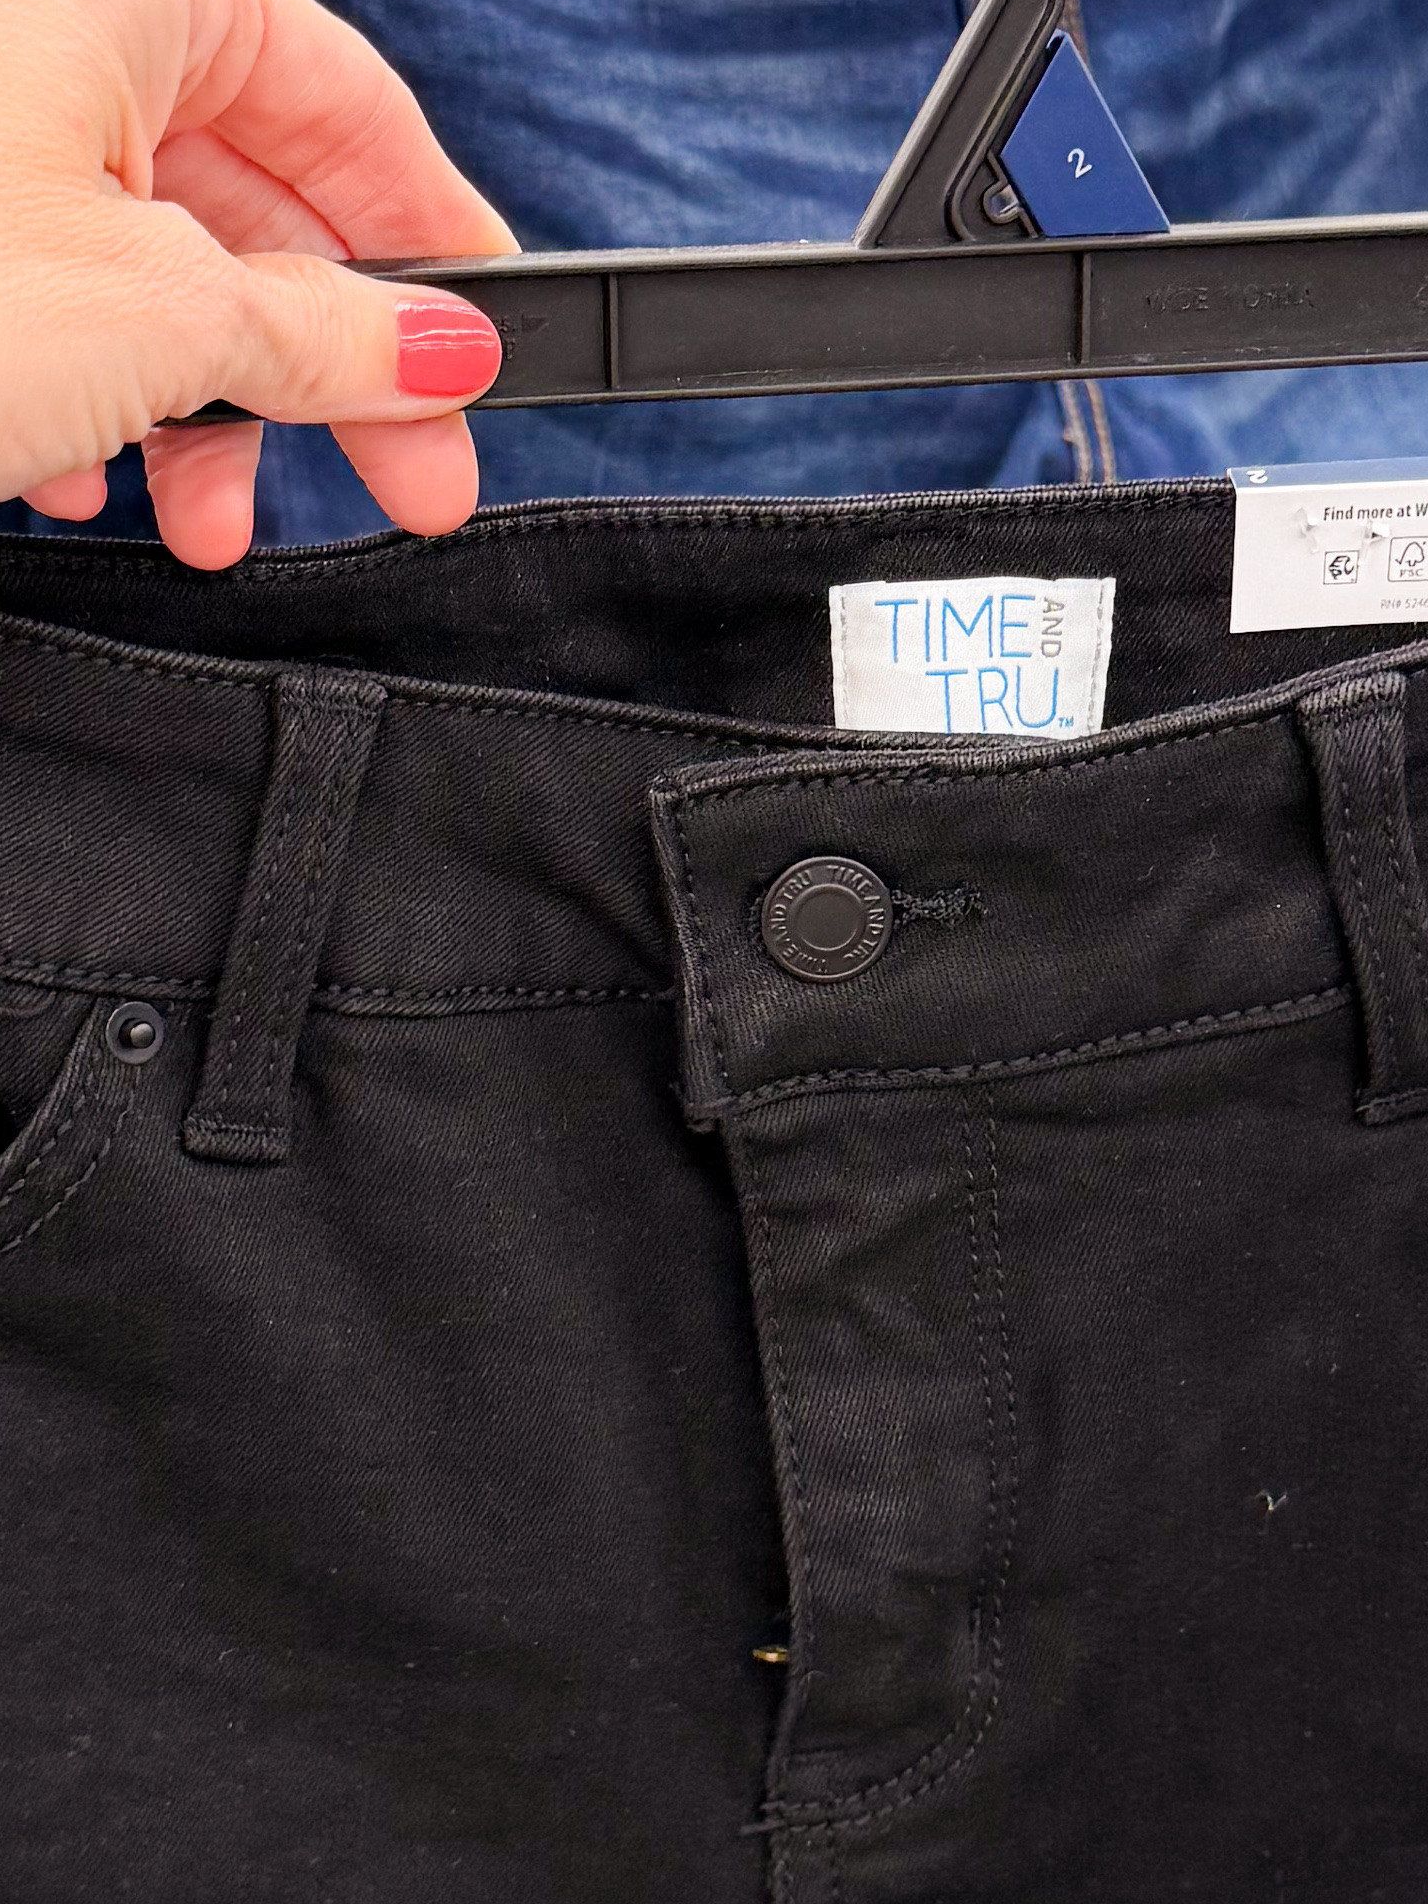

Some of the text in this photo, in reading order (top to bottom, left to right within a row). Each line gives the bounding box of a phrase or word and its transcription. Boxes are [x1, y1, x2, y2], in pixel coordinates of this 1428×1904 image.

[1067, 148, 1092, 179] 2
[1323, 506, 1353, 521] Find
[1357, 507, 1393, 519] more
[1396, 505, 1411, 518] at
[874, 594, 1036, 663] TIME
[1040, 597, 1065, 658] AND
[925, 665, 1059, 734] TRU
